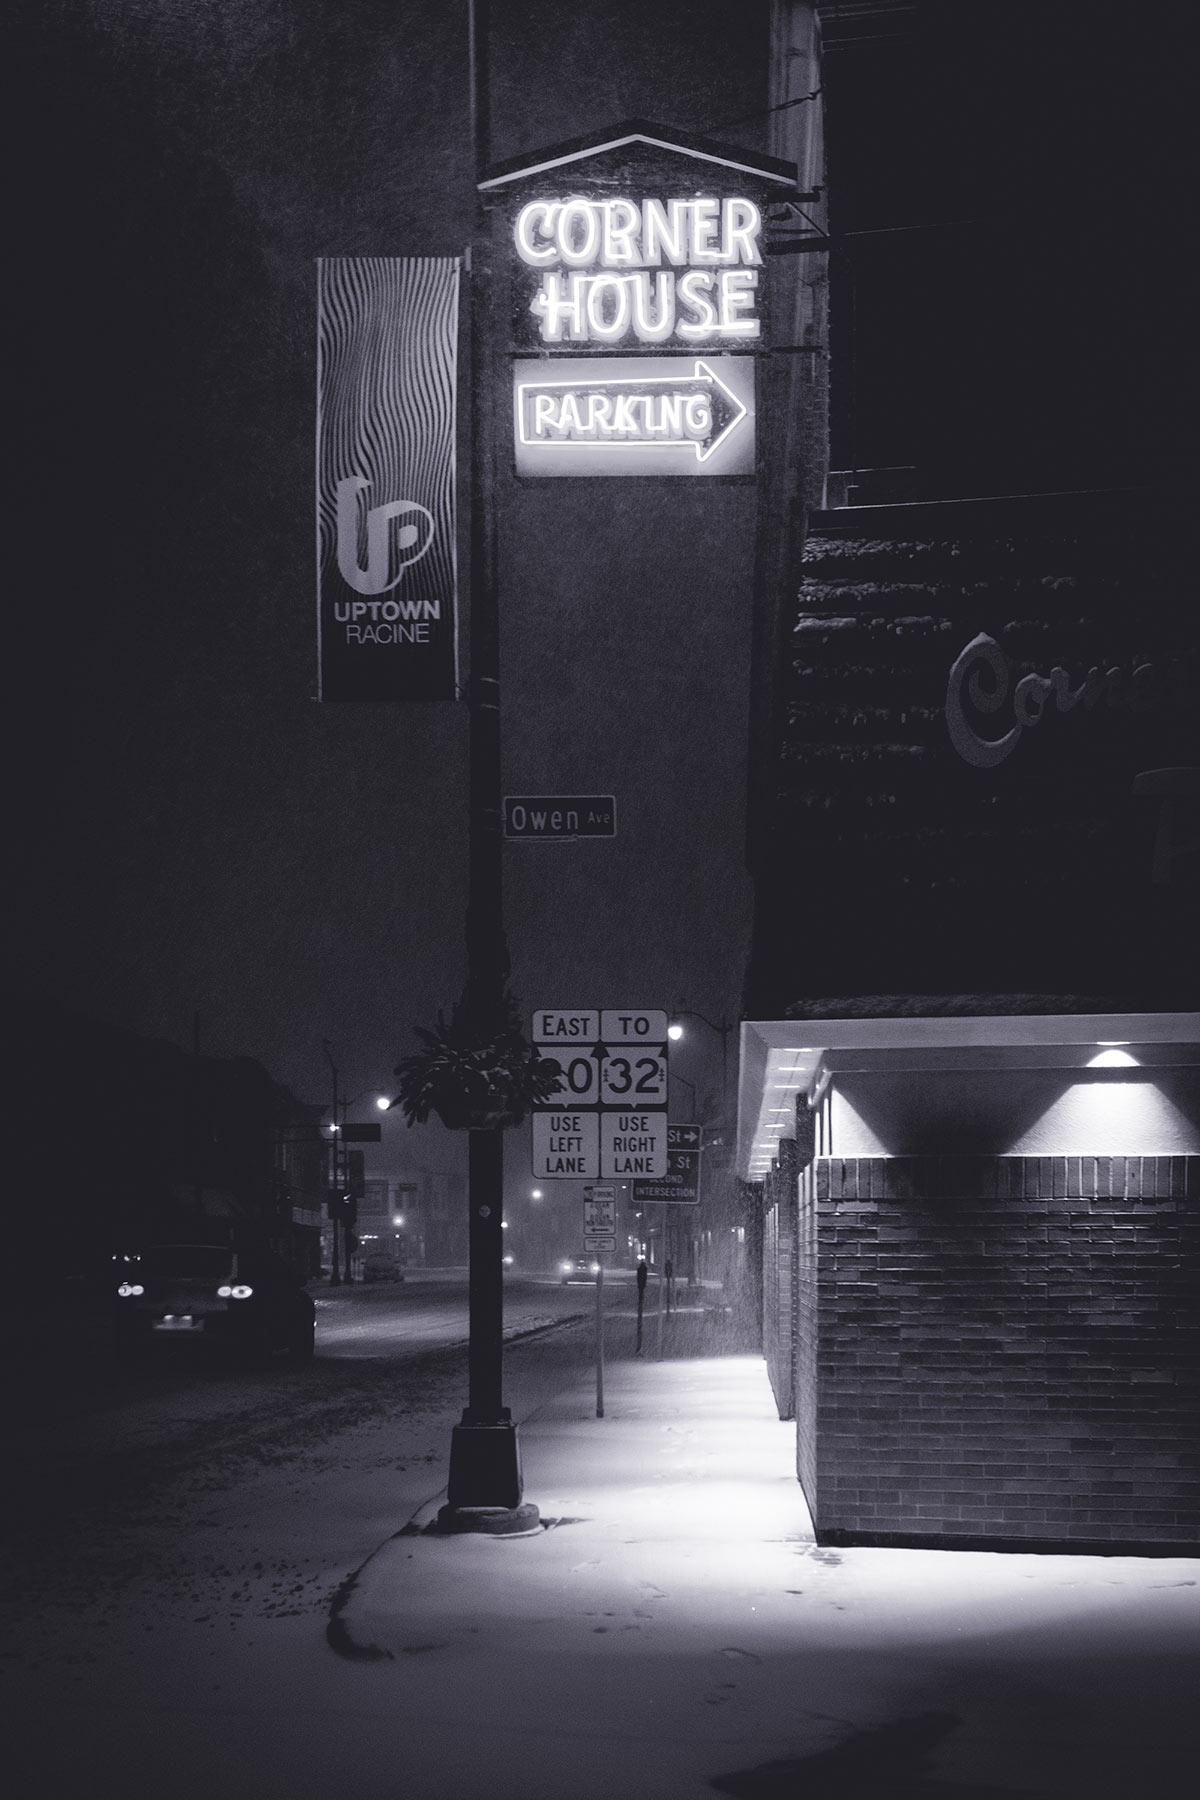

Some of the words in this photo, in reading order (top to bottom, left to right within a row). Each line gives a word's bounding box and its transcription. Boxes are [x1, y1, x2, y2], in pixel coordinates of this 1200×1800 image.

[515, 198, 763, 267] CORNER
[530, 270, 760, 342] HOUSE
[533, 394, 712, 440] PARKING
[334, 600, 440, 622] UPTOWN
[346, 623, 430, 644] RACINE
[512, 805, 579, 831] Owen
[587, 811, 610, 824] Ave
[543, 1015, 590, 1036] EAST
[618, 1016, 650, 1035] TO
[608, 1057, 660, 1094] 32
[551, 1116, 581, 1132] USE
[619, 1116, 649, 1132] USE
[550, 1137, 583, 1152] LEFT
[613, 1137, 656, 1152] RIGHT
[668, 1129, 681, 1143] St
[546, 1157, 586, 1173] LANE
[615, 1157, 654, 1173] LANE
[677, 1155, 691, 1169] St
[635, 1186, 696, 1197] INTERSECTION
